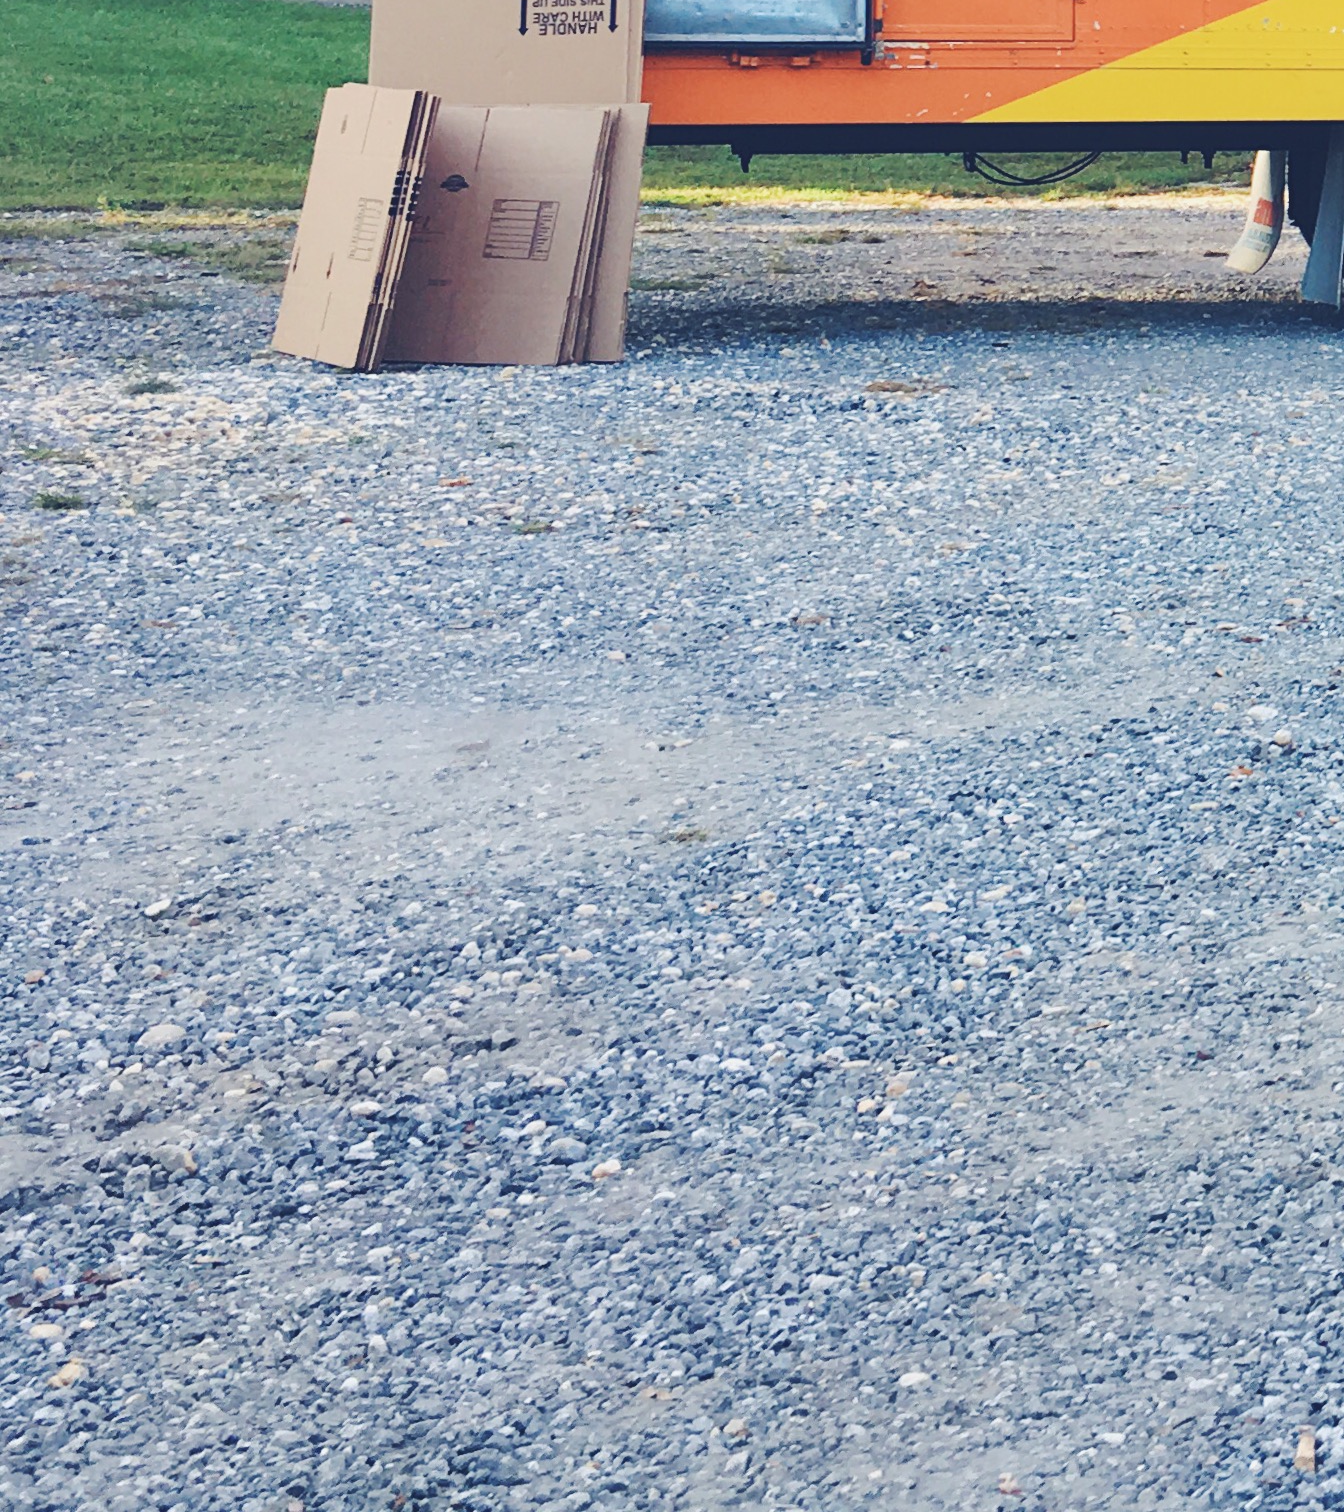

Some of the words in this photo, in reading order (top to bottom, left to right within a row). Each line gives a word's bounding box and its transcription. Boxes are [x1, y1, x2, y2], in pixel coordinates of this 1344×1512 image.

[532, 11, 569, 24] CARE
[572, 10, 605, 22] WITH
[538, 21, 598, 36] HANDLE
